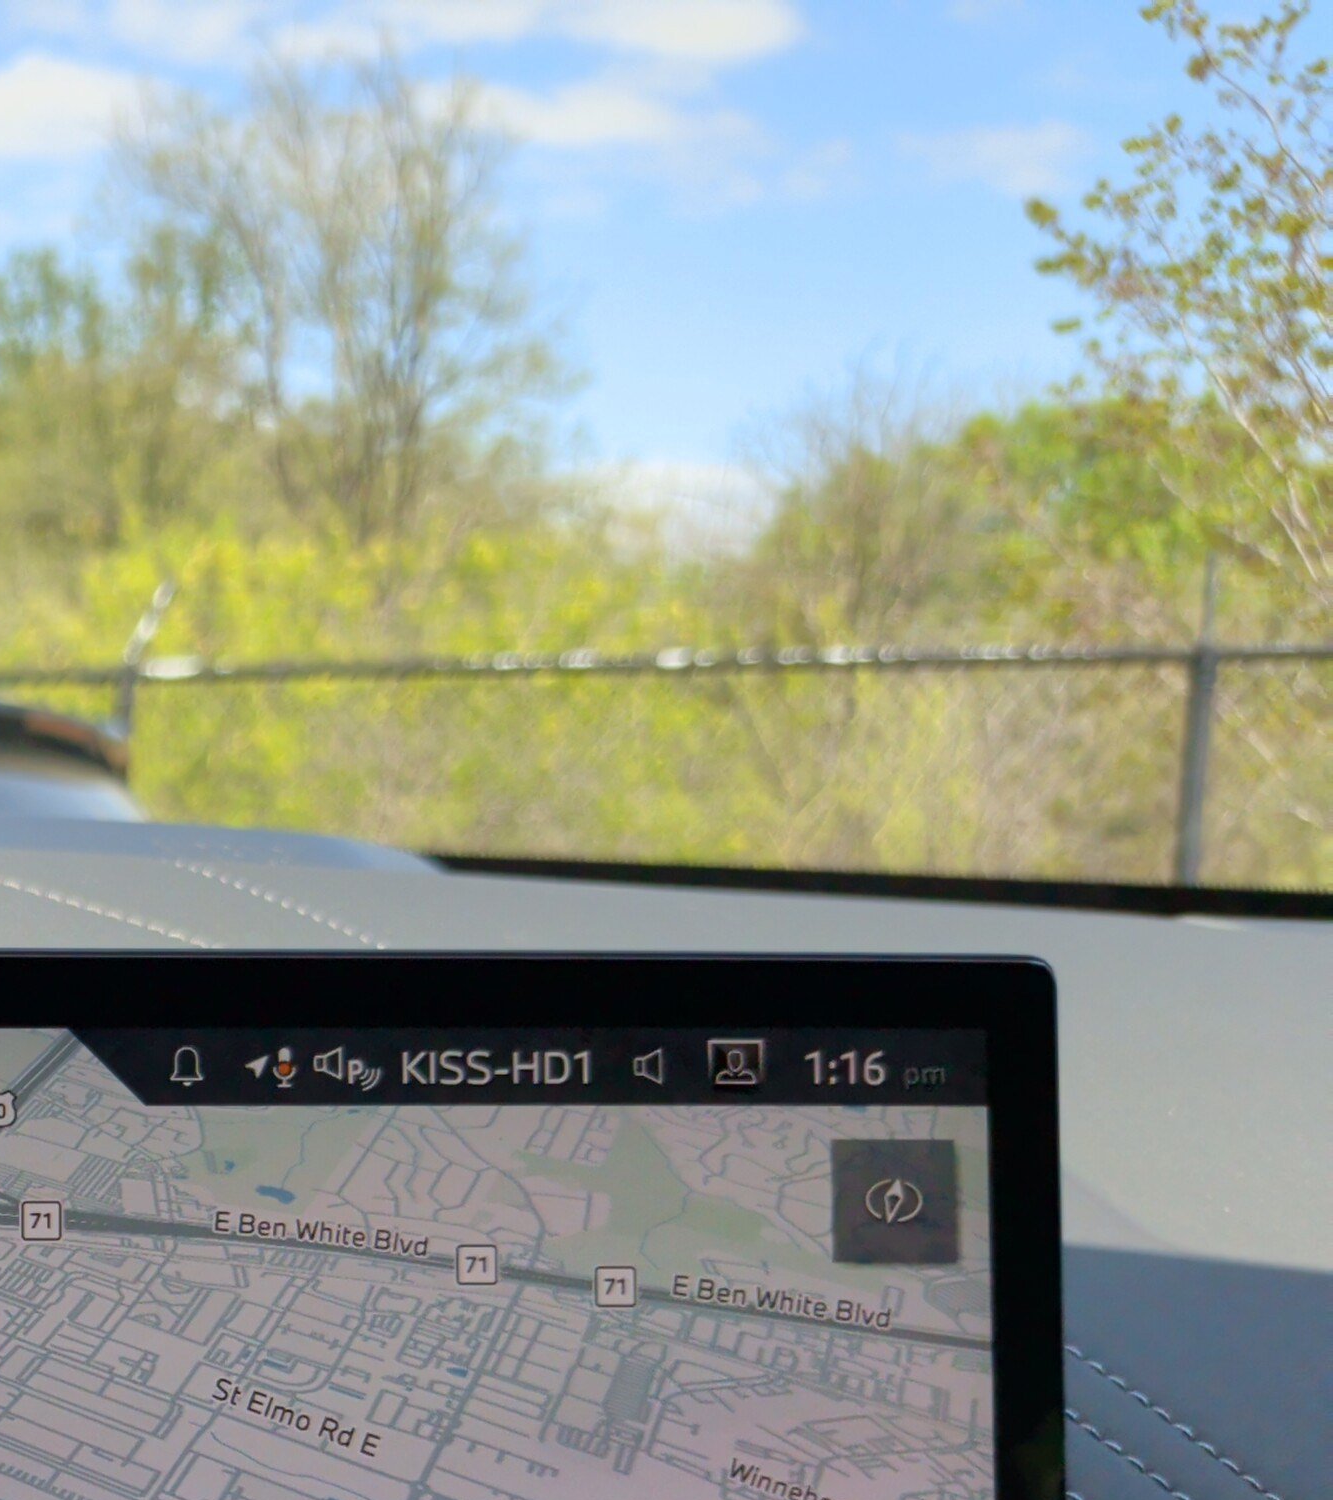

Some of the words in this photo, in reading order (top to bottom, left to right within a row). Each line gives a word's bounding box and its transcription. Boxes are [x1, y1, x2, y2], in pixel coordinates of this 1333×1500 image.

[401, 1051, 593, 1086] KISS-HD1
[804, 1051, 888, 1086] 1:16
[904, 1066, 947, 1090] pm
[30, 1212, 53, 1231] 71
[214, 1210, 230, 1232] E
[239, 1214, 287, 1239] Ben
[296, 1219, 366, 1248] White
[374, 1229, 429, 1257] Blvd
[465, 1256, 489, 1275] 71
[604, 1278, 628, 1297] 71
[672, 1275, 689, 1297] E
[698, 1279, 747, 1305] Ben
[755, 1285, 828, 1319] White
[835, 1298, 892, 1329] Blvd
[211, 1377, 243, 1408] St
[248, 1391, 311, 1432] Elmo
[318, 1418, 353, 1449] Rd
[359, 1433, 382, 1457] E
